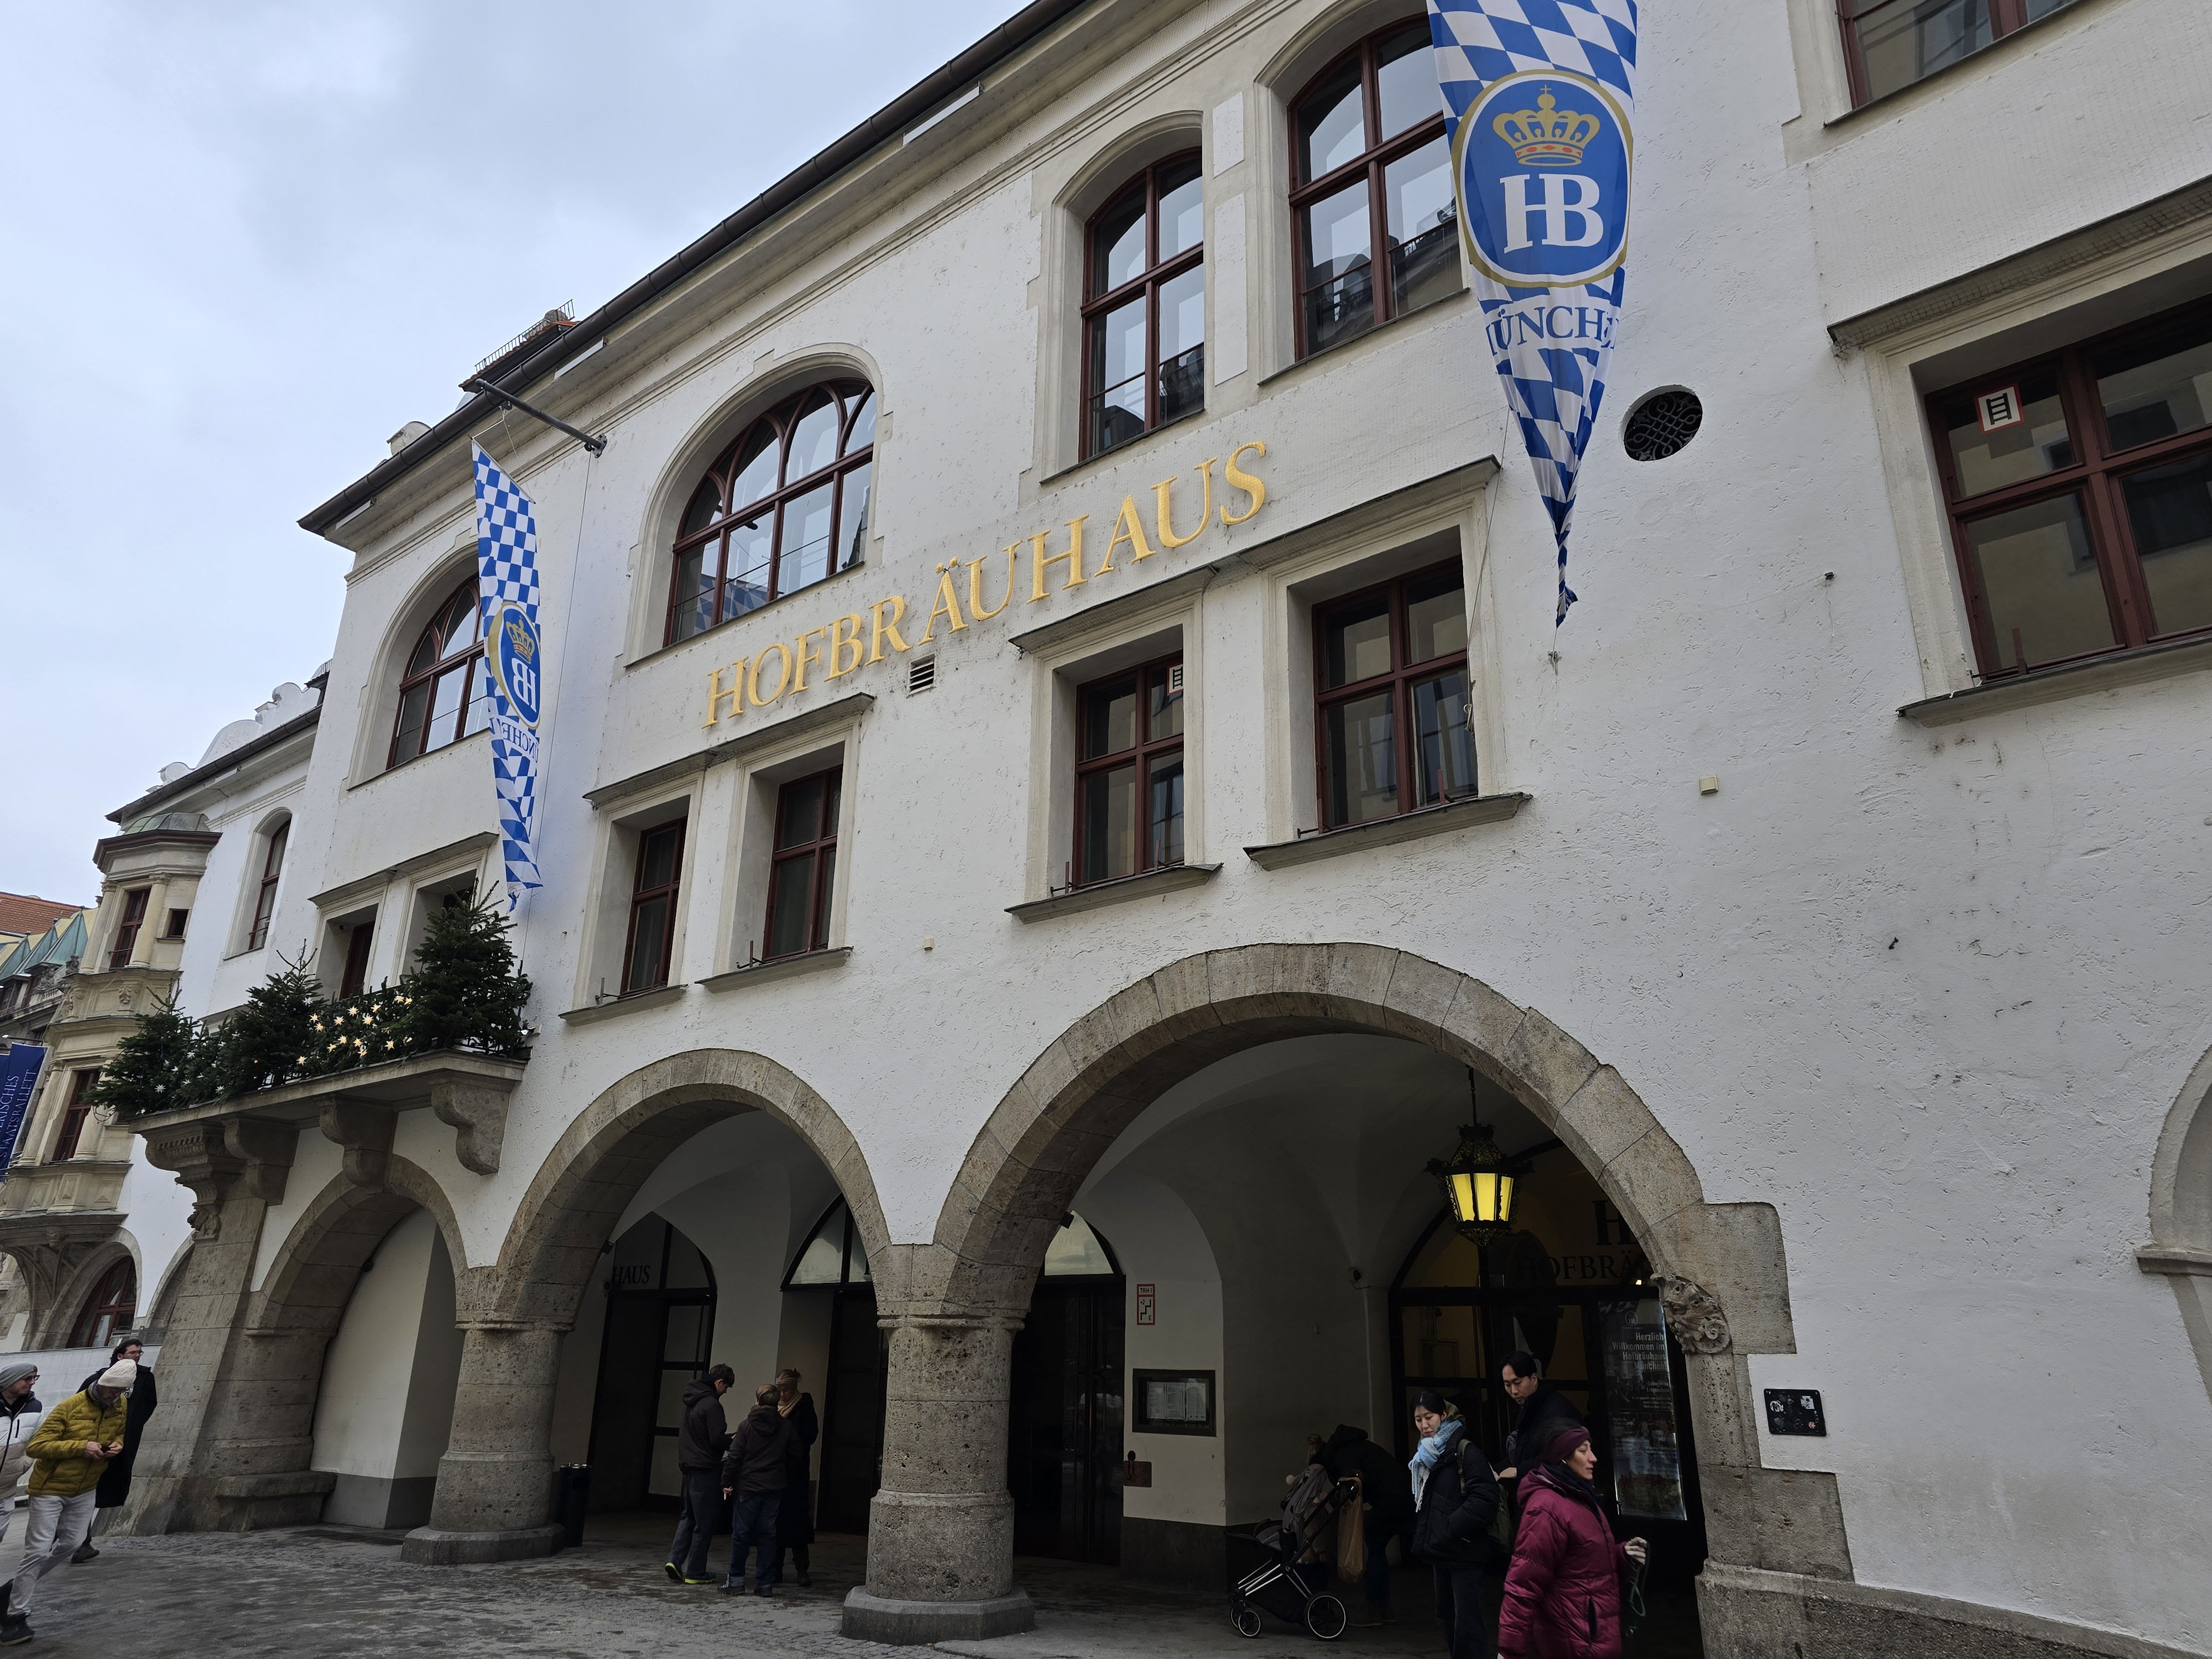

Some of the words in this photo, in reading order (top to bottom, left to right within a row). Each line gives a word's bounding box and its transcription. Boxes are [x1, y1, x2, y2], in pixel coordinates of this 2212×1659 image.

[1499, 173, 1604, 254] HB
[1485, 305, 1619, 357] ÜNCHE
[701, 440, 1266, 729] HOFBRÄUHAUS
[0, 1075, 19, 1128] ISCHES
[0, 1069, 36, 1157] STAATSBALLETT
[1514, 1249, 1647, 1281] HOFBRÄ
[1612, 1342, 1654, 1350] Willkommen
[1623, 1352, 1666, 1360] Hofbräuhaus
[1636, 1332, 1663, 1341] Herzlich
